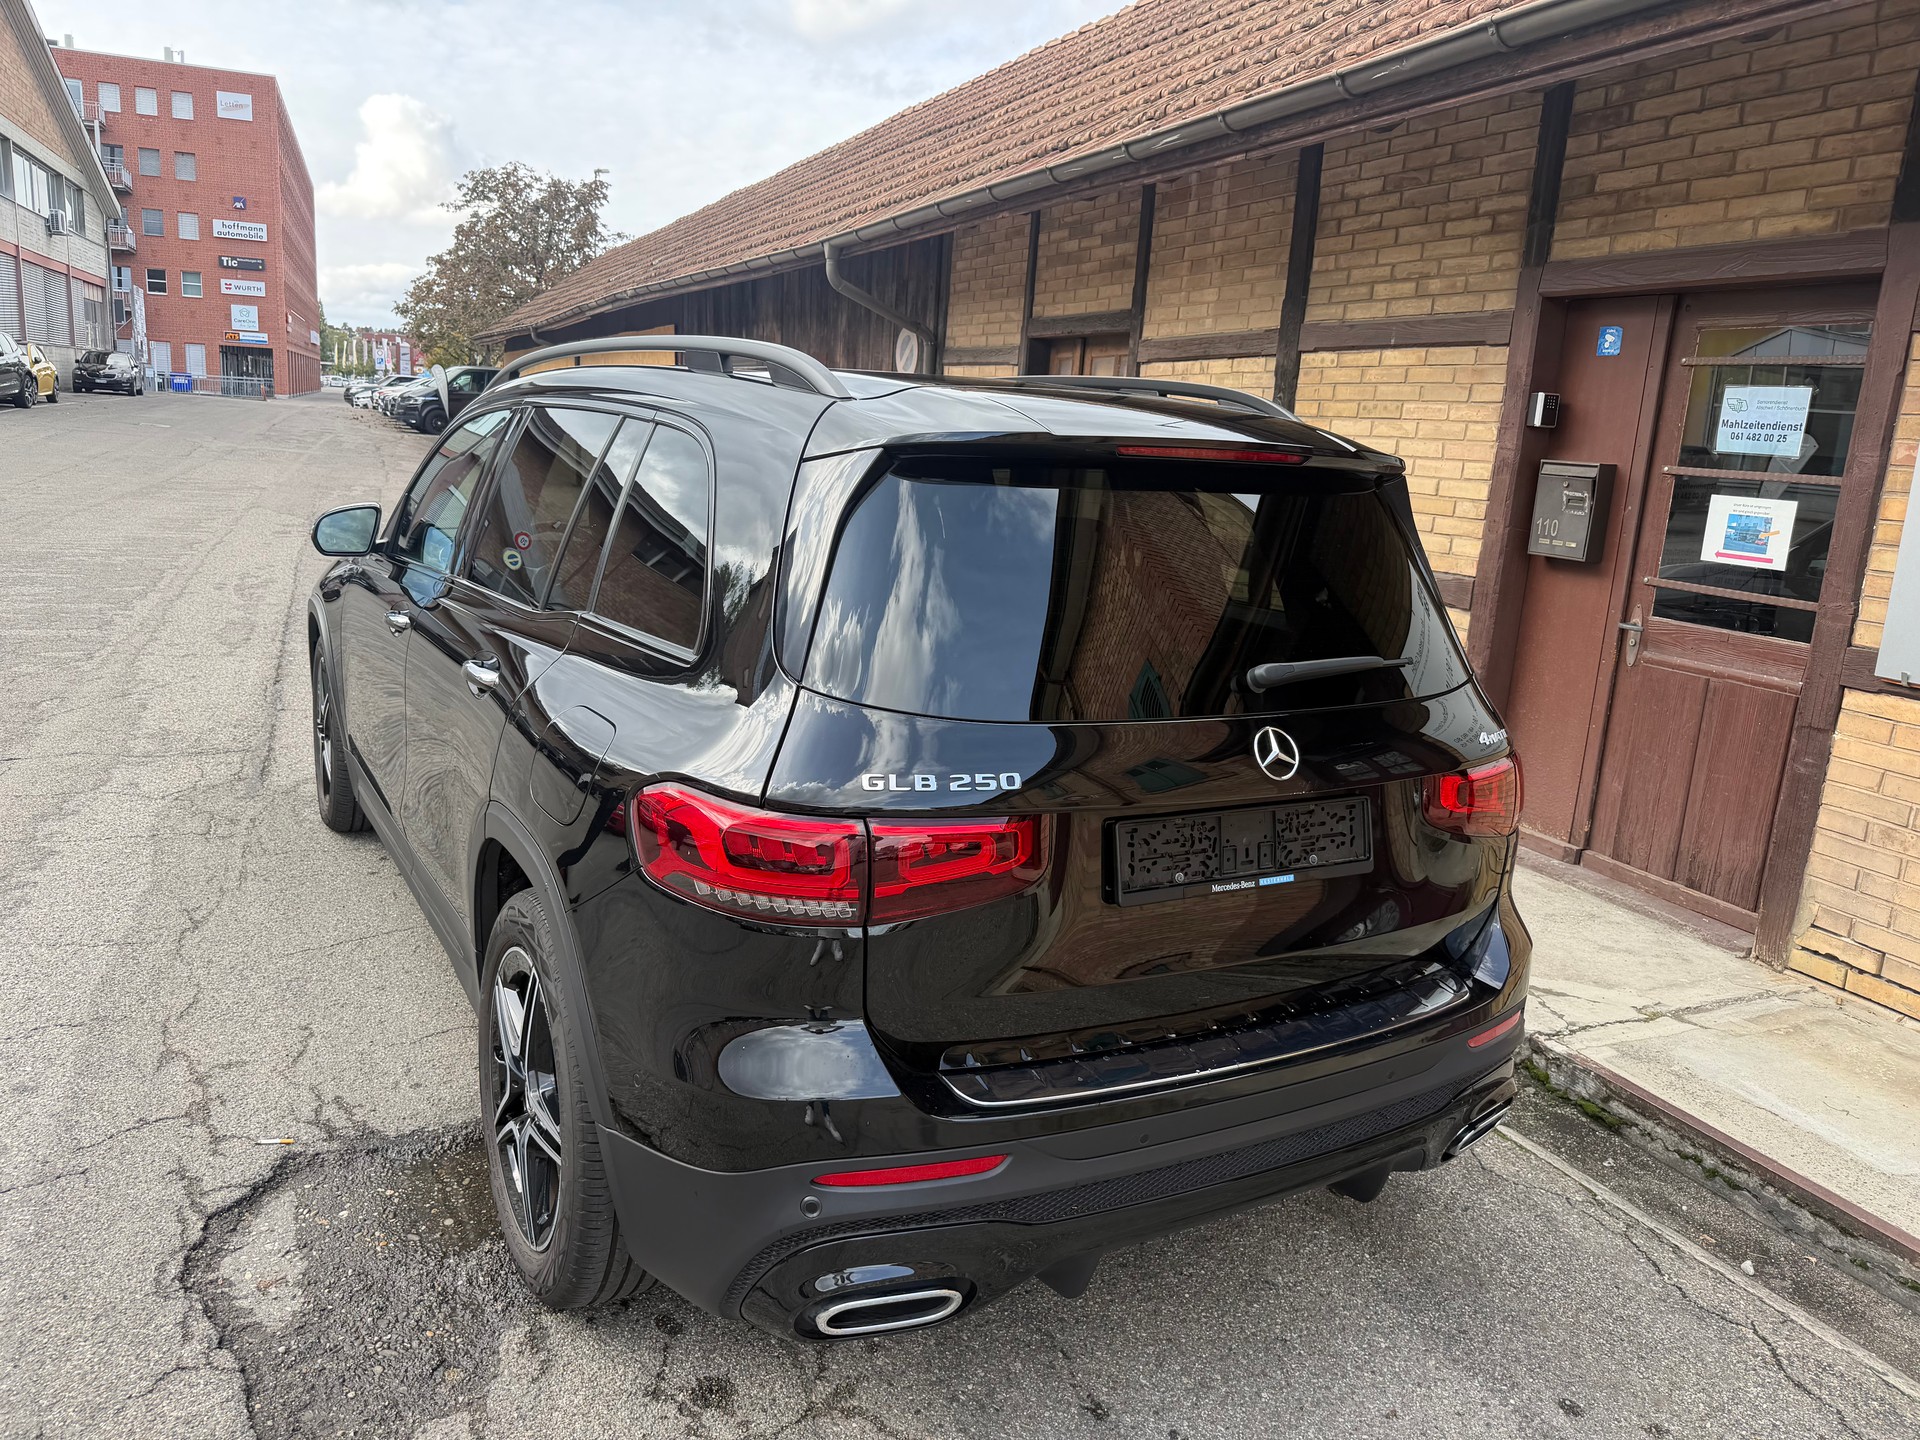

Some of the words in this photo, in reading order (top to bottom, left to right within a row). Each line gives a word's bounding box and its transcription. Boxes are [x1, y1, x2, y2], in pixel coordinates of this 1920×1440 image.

[221, 221, 264, 233] hoffmann
[216, 230, 264, 240] automobile
[221, 256, 238, 267] Tic
[1721, 419, 1803, 432] Mahlzeitendienst
[1730, 431, 1744, 441] 061
[1746, 432, 1761, 442] 482
[1763, 433, 1774, 442] 00
[1776, 434, 1788, 443] 25
[1536, 517, 1559, 537] 110
[861, 773, 938, 791] GLB
[949, 772, 1023, 791] 250
[1211, 880, 1256, 893] Mercedes-Benz
